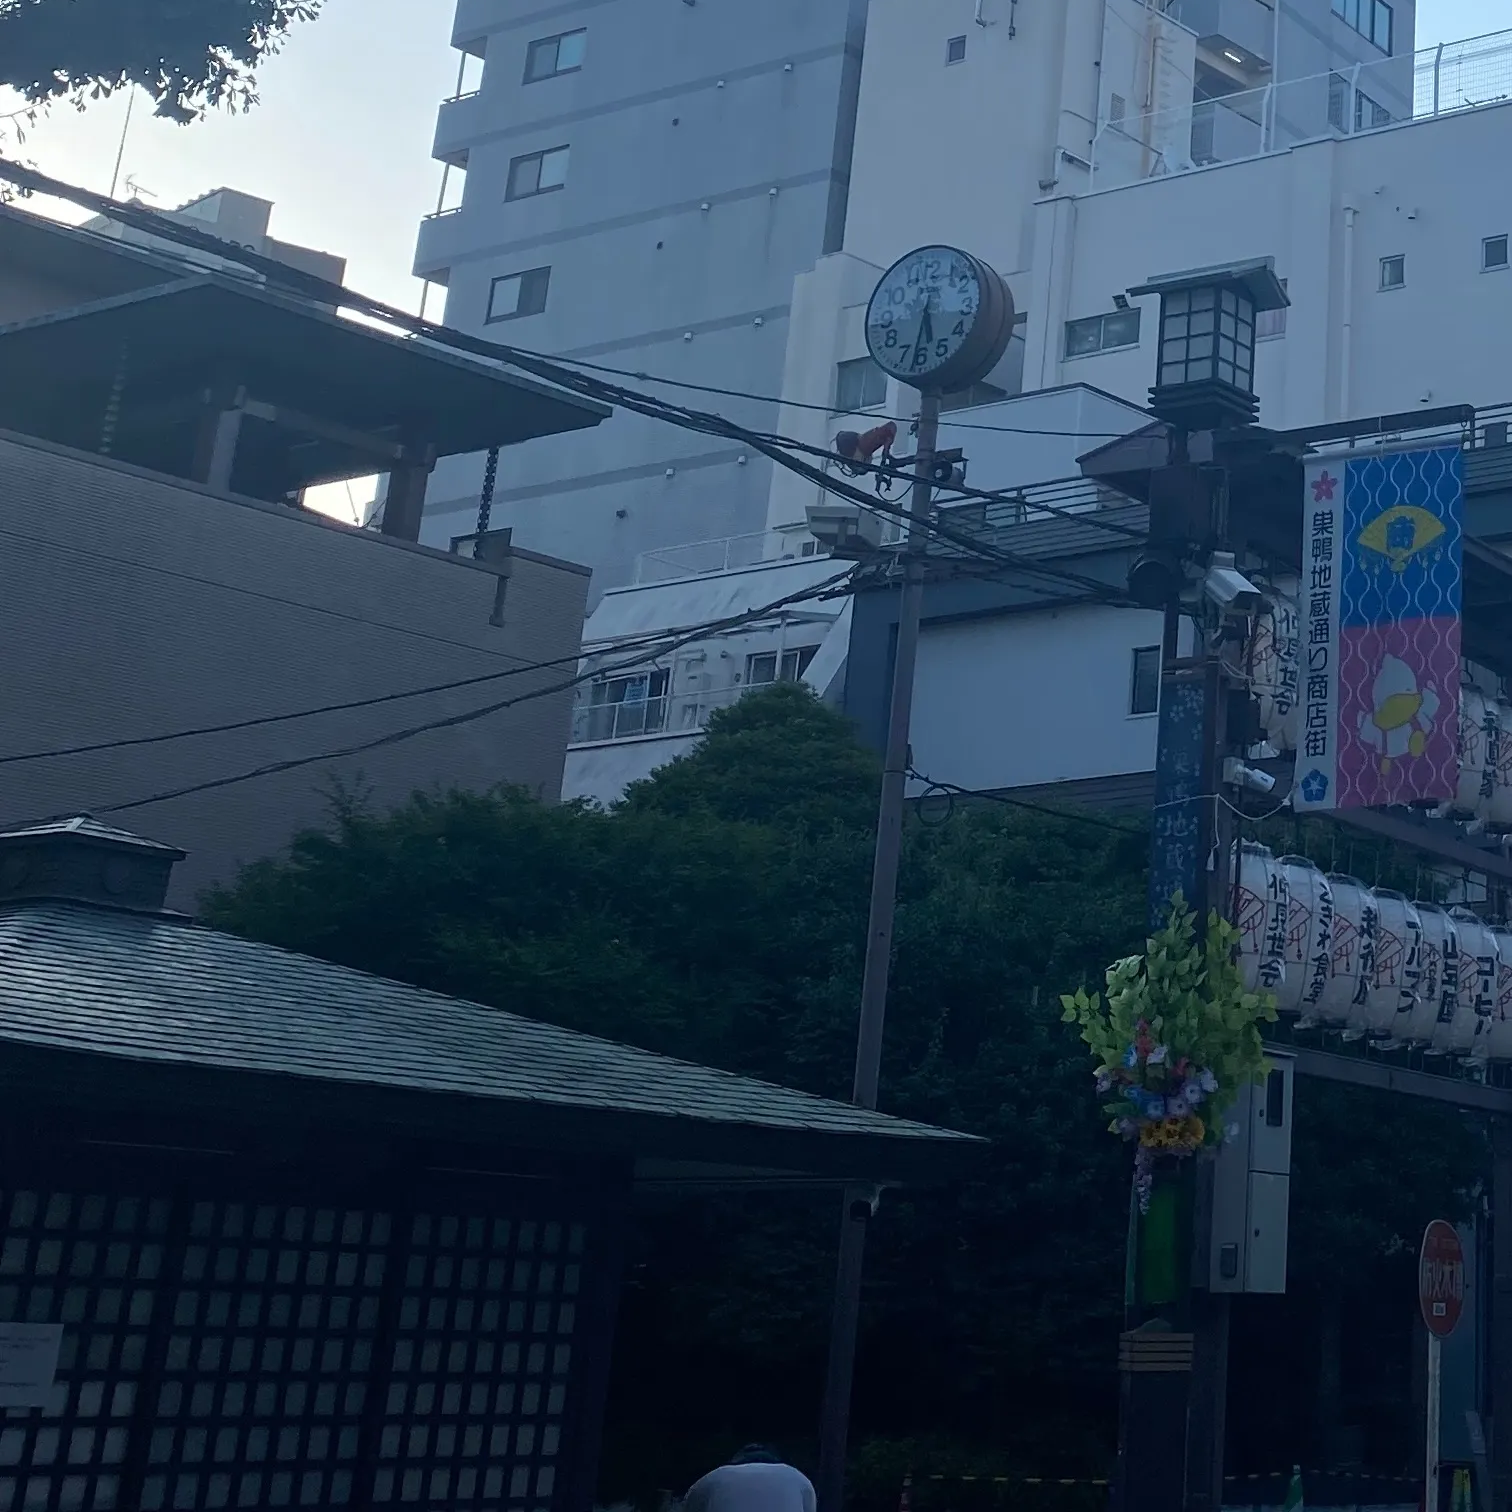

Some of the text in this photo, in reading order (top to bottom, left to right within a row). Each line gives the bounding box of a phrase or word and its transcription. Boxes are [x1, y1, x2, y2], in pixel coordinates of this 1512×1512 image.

[958, 275, 969, 294] 2
[885, 285, 905, 305] 10
[960, 296, 974, 315] 3
[880, 310, 893, 329] 9
[952, 319, 965, 337] 4
[884, 328, 898, 348] 8
[935, 338, 949, 357] 5
[899, 344, 911, 364] 7
[915, 346, 928, 366] 6
[1304, 509, 1334, 757] 巣鴨地蔵通り商店街
